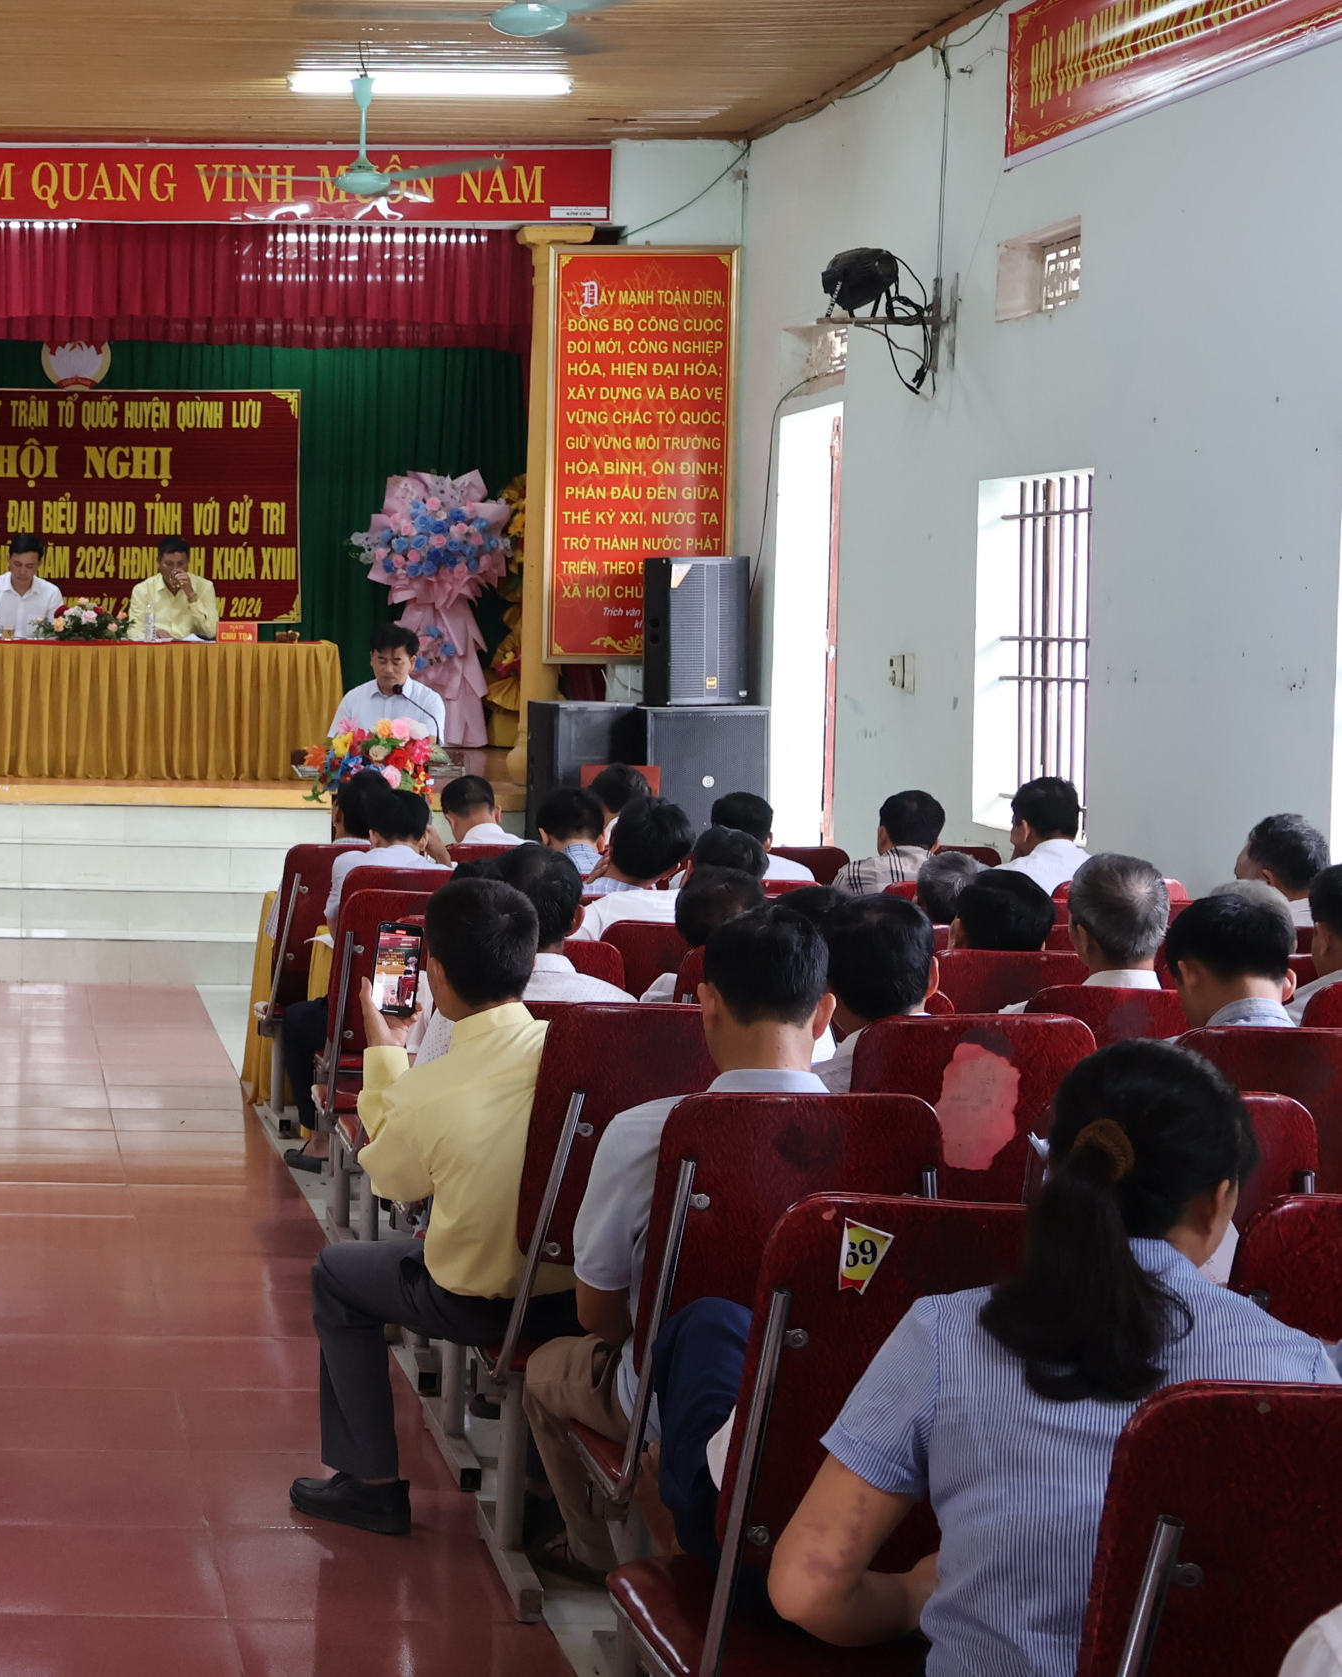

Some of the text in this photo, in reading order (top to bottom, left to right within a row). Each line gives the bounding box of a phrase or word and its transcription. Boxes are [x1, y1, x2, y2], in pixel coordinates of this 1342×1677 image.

[1030, 24, 1053, 119] HỘI
[31, 161, 177, 208] QUANG
[195, 163, 295, 202] VINH
[317, 154, 435, 203] MÔN
[457, 153, 545, 204] NĂM
[619, 287, 725, 308] MẠNH TOÀN DIỆN,
[568, 316, 723, 335] ĐỒNG BỘ CÔNG CUỘC
[567, 338, 723, 356] ĐỔI MỚI, CÔNG NGHIỆP
[567, 360, 722, 378] HÓA, HIỆN ĐẠI HÓA;
[567, 384, 723, 403] XÂY DỰNG VÀ BẢO VỆ
[10, 395, 48, 430] TRẬN
[58, 393, 79, 427] TỔ
[82, 394, 118, 431] QUỐC
[124, 397, 170, 432] HUYỆN
[176, 396, 223, 432] QUỲNH
[232, 398, 262, 428] LƯU
[566, 409, 725, 426] VỮNG CHẮC TỔ QUỐC,
[566, 437, 721, 450] GIỮ VỮNG MÔI TRƯỜNG
[83, 446, 172, 487] NGHỊ
[565, 458, 723, 477] HÒA BÌNH, ỔN ĐỊNH;
[566, 484, 719, 499] PHẤN ĐẤU ĐẾN GIỮA
[7, 500, 35, 535] ĐẠI
[42, 492, 78, 534] BIỂU
[84, 501, 136, 535] HĐND
[144, 493, 182, 535] TỈNH
[193, 496, 220, 535] VỚI
[228, 494, 253, 535] CỬ
[260, 502, 286, 535] TRI
[562, 509, 719, 526] THẾ KỶ XXI, NƯỚC TA
[562, 535, 720, 550] TRỞ THÀNH NƯỚC PHÁT
[38, 541, 70, 579] NĂM
[75, 546, 116, 579] 2024
[212, 542, 256, 580] KHÓA
[260, 547, 296, 580] XVIII
[561, 558, 599, 575] TRIỂN,
[603, 561, 635, 575] THEO
[562, 583, 643, 601] XÃ HỘI CHỦ
[229, 597, 262, 618] 2024
[603, 607, 641, 616] Trích văn
[845, 1239, 878, 1268] 69
